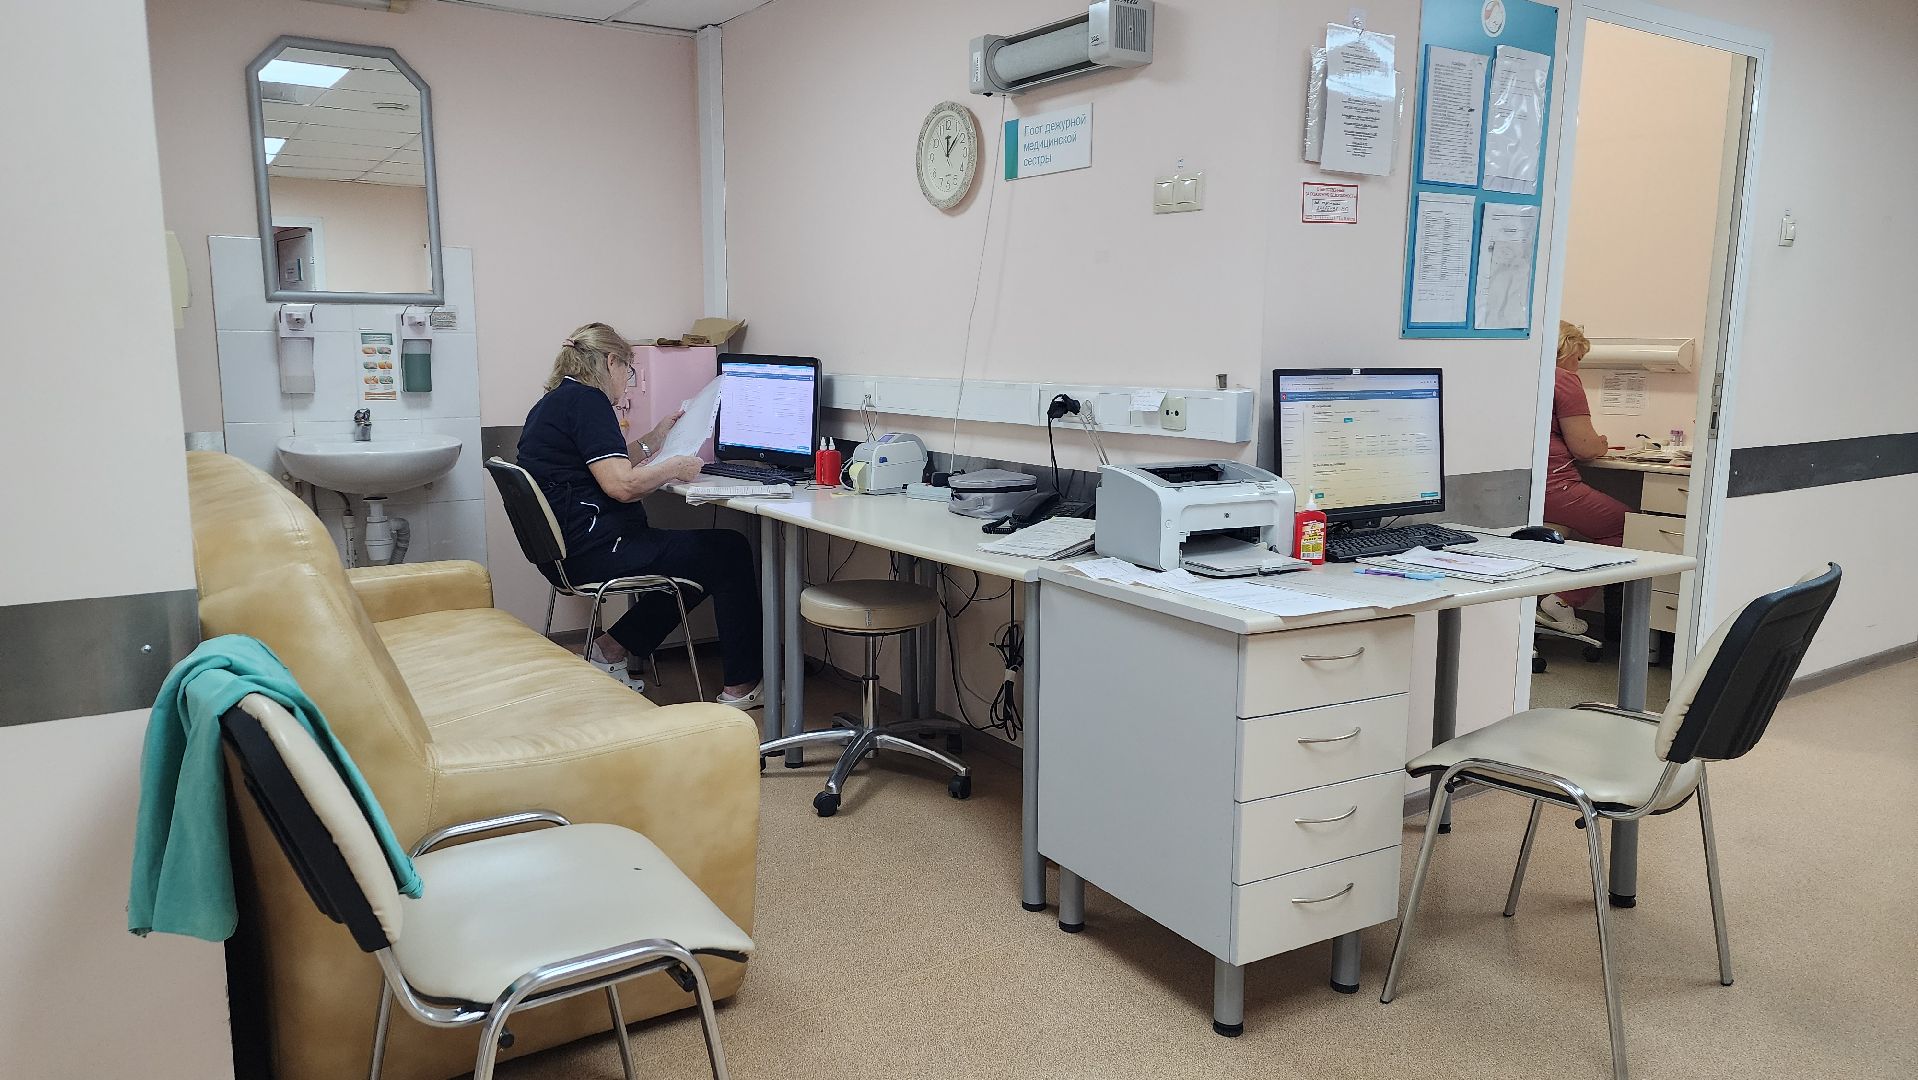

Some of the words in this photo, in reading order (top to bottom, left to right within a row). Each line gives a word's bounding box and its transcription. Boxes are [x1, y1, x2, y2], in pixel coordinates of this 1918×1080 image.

[945, 119, 952, 131] 12
[1044, 113, 1087, 134] дежурной
[960, 132, 966, 144] 2
[1023, 131, 1077, 152] медицинской
[962, 146, 968, 158] 3
[1023, 153, 1052, 167] сестры
[959, 161, 965, 172] 4
